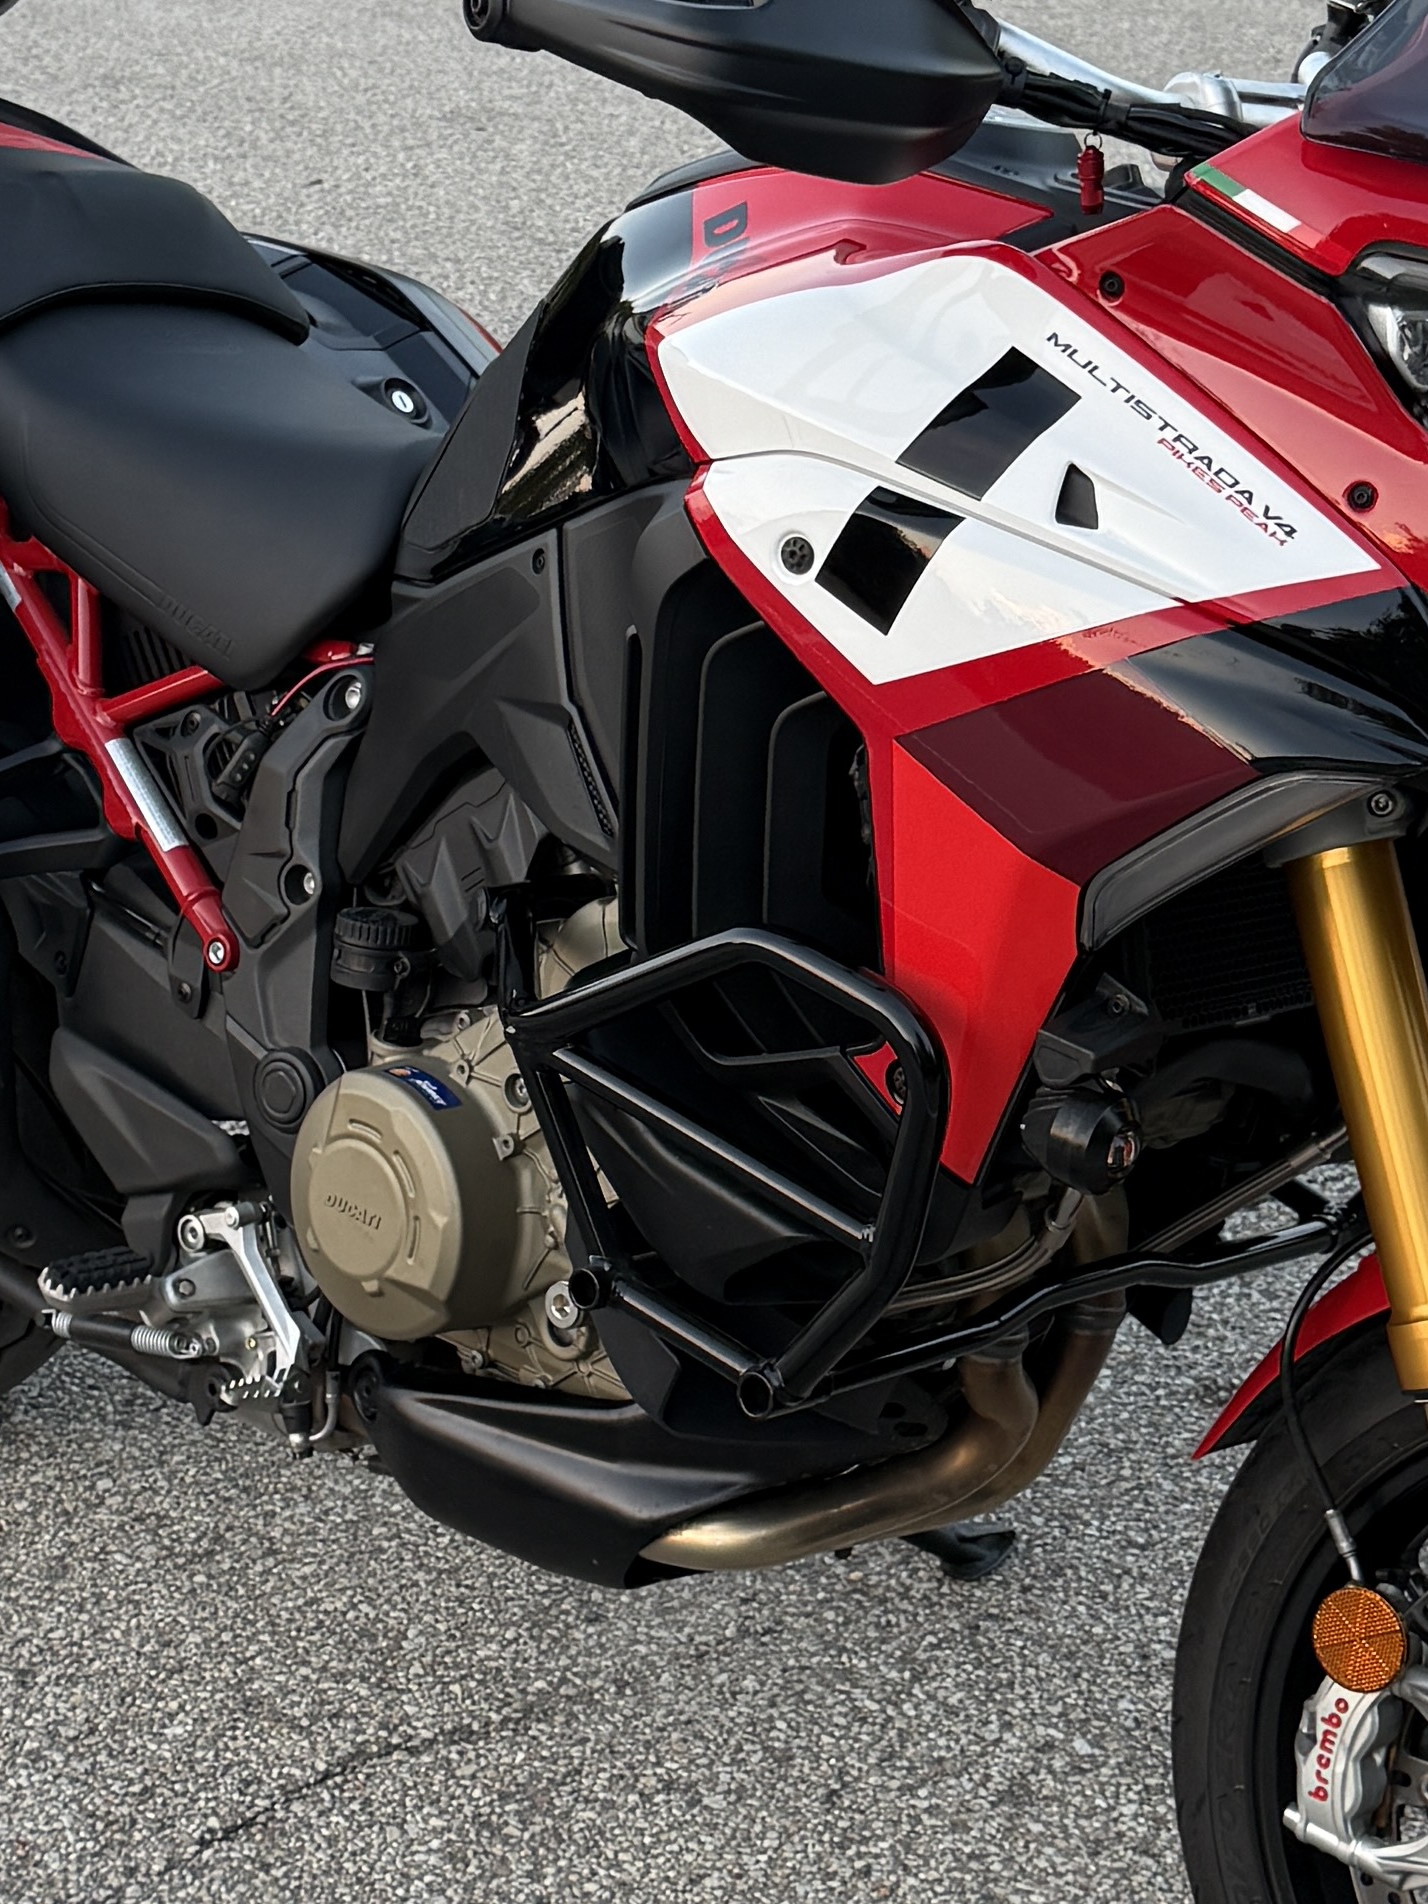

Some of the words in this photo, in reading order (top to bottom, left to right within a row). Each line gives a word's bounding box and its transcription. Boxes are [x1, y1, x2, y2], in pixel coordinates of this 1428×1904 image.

[1046, 332, 1255, 507] MULTISTRADA
[1261, 504, 1300, 541] V4
[1157, 437, 1226, 495] PIKES
[1225, 494, 1289, 548] PEAK
[324, 1193, 382, 1231] DUCATI
[1308, 1697, 1350, 1802] brembo
